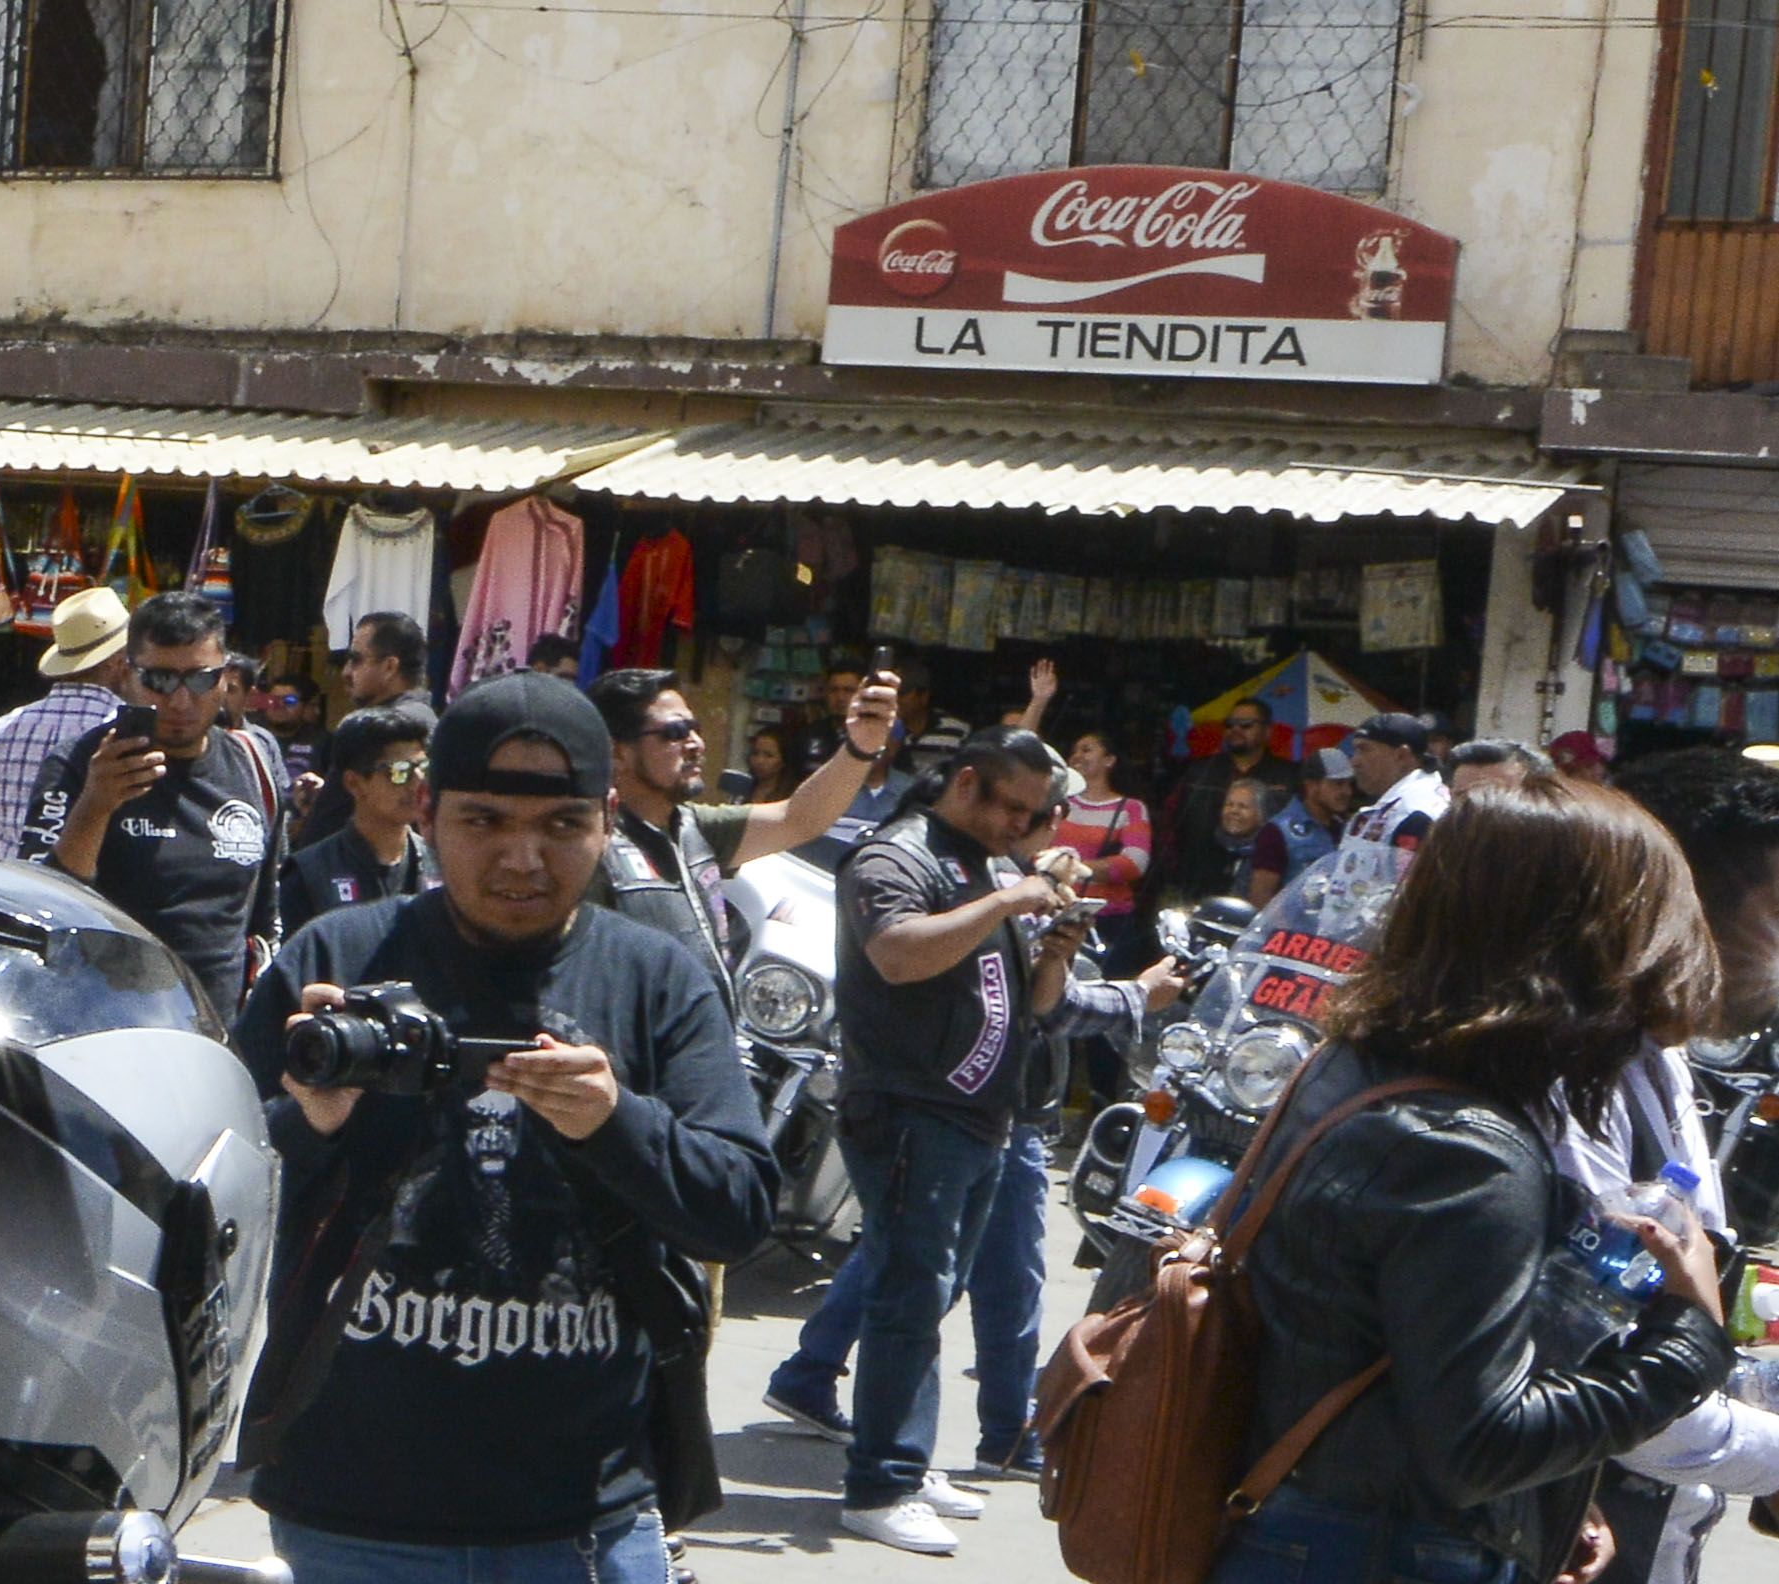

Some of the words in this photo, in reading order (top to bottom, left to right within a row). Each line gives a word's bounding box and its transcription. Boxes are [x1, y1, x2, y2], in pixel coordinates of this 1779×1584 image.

[1030, 179, 1261, 249] Coca-Cola
[915, 316, 987, 356] LA
[1036, 320, 1308, 367] TIENDITA
[960, 962, 1005, 1083] FRESNILLO
